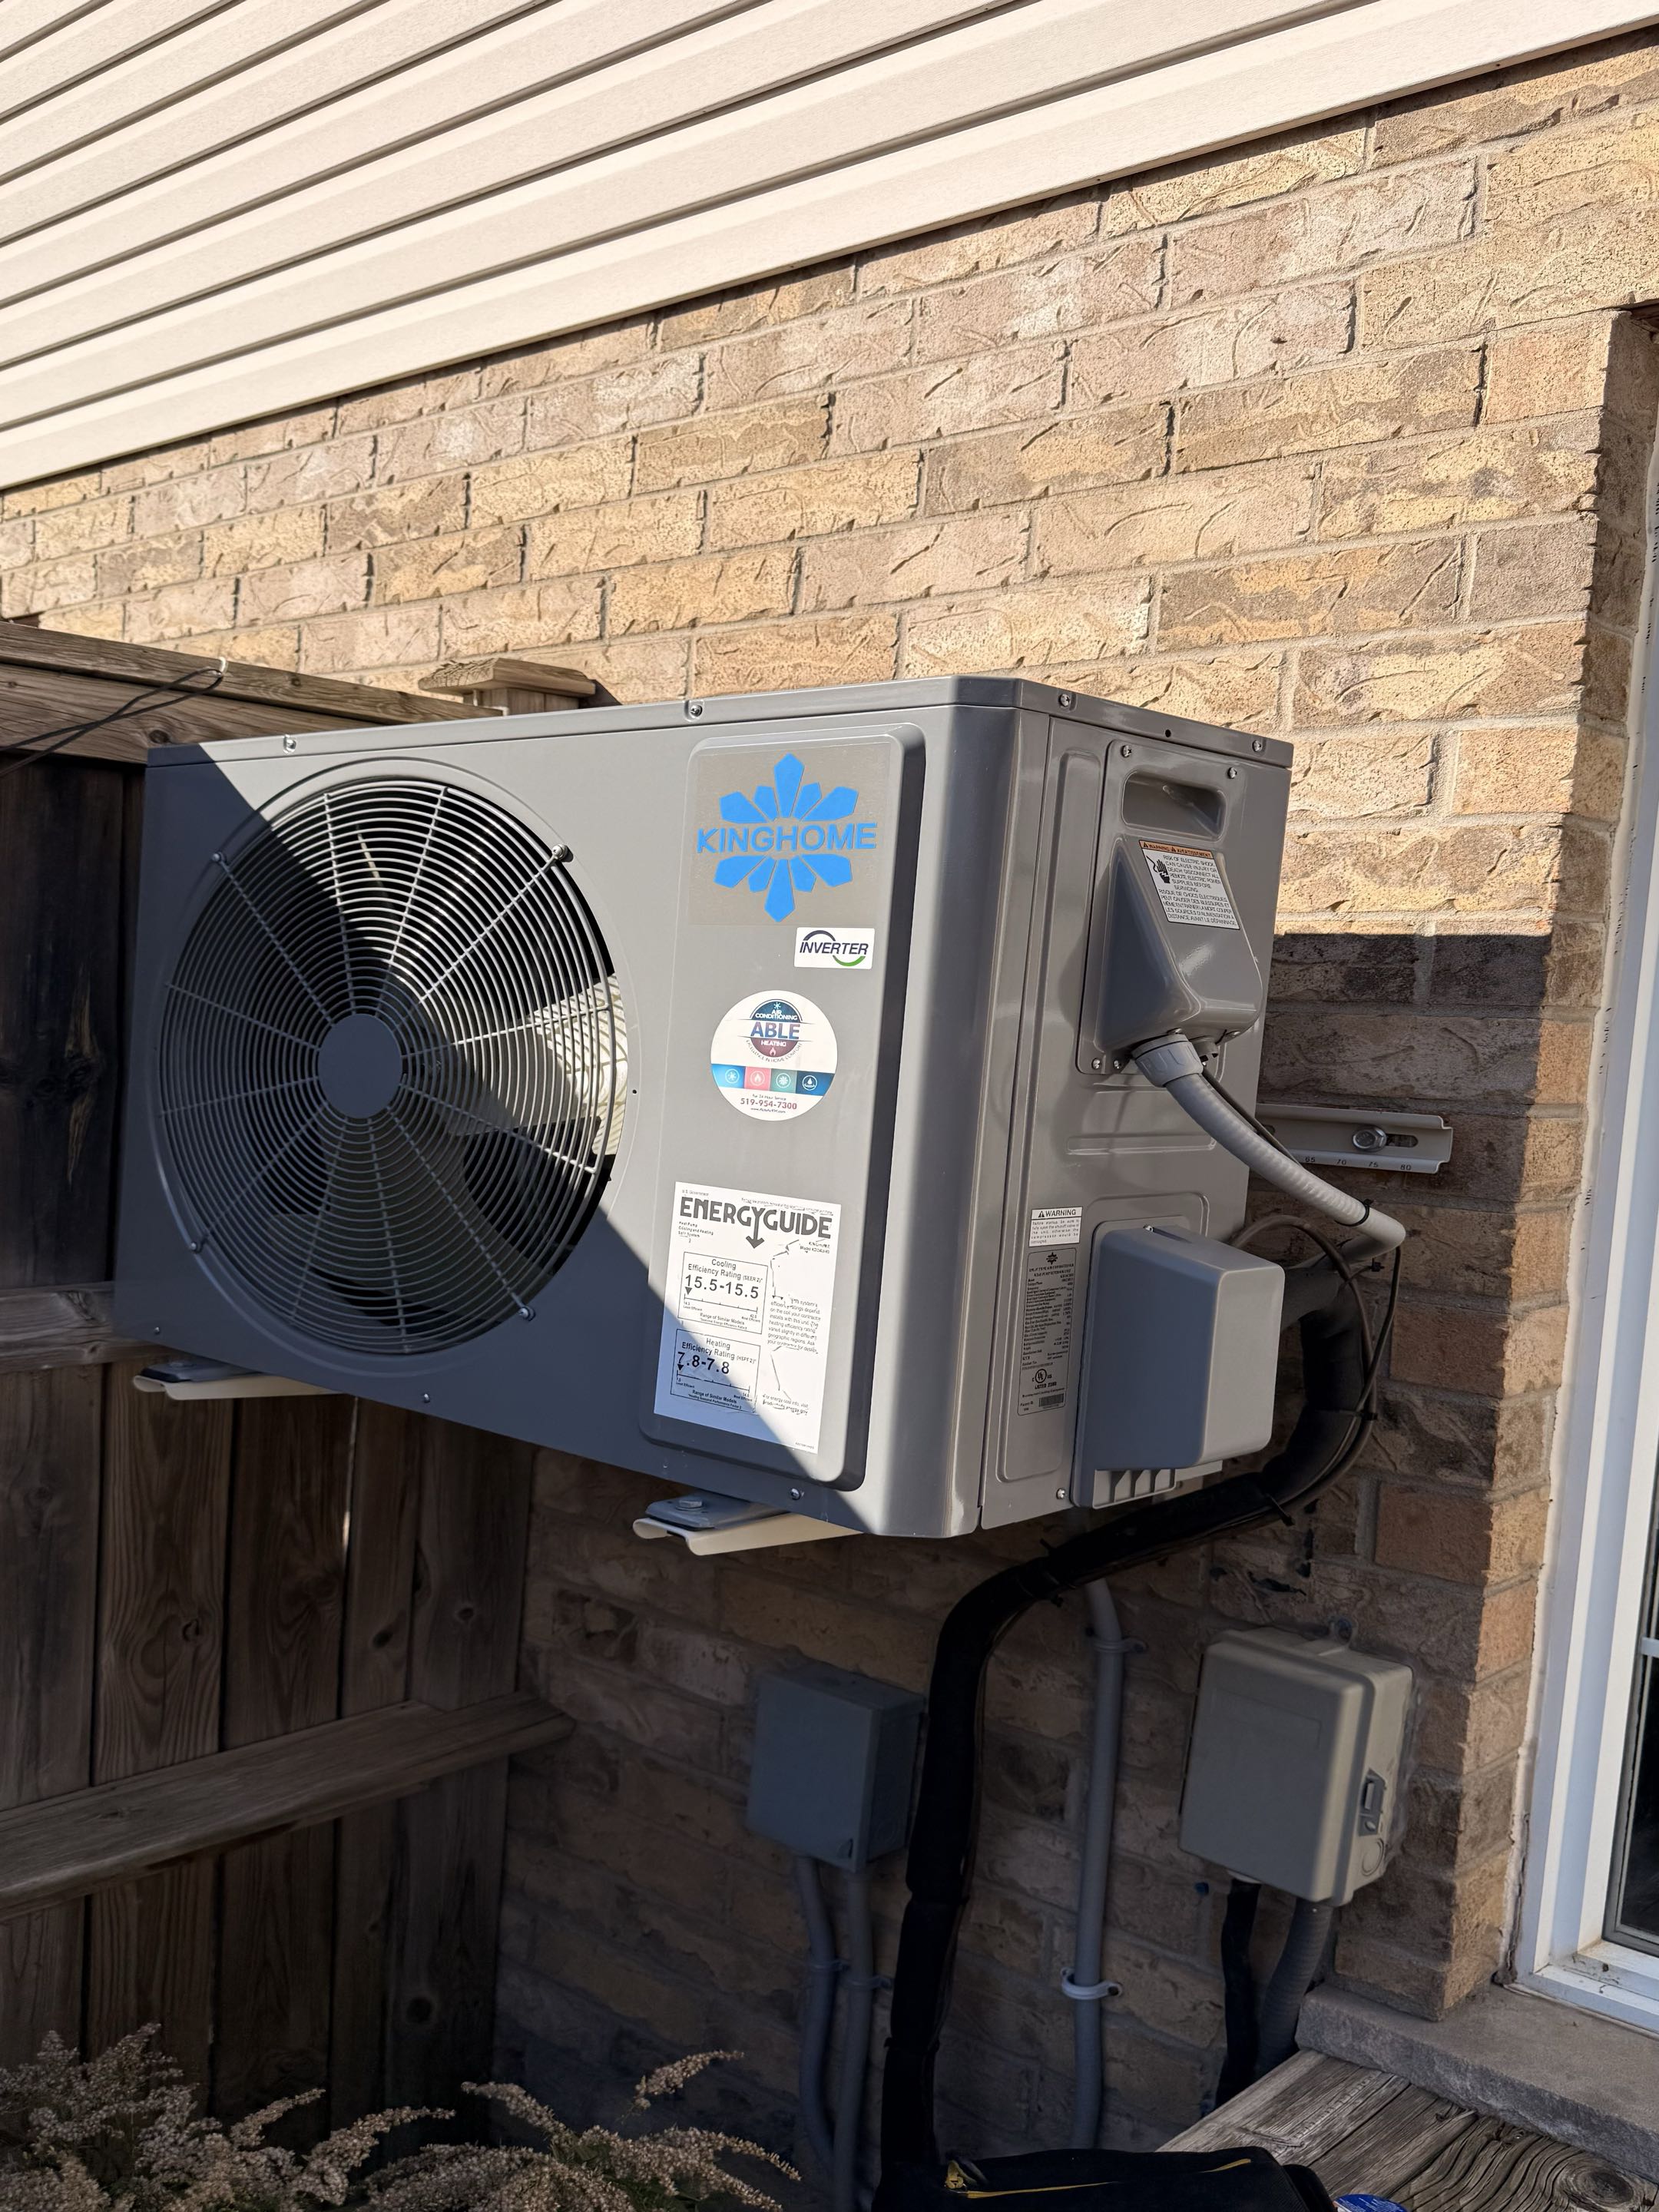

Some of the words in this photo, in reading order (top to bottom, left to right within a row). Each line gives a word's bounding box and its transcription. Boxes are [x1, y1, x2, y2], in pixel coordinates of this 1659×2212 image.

[697, 823, 877, 853] KINGHOME
[800, 942, 869, 955] INVERTER
[755, 1013, 798, 1022] CONDITIONING
[750, 1022, 800, 1040] ABLE
[740, 1098, 797, 1110] 519-954-7300
[680, 1196, 832, 1239] ENERGYGUIDE
[688, 1263, 719, 1277] Efficiency
[720, 1269, 741, 1280] Rating
[711, 1259, 737, 1270] Cooling
[685, 1274, 759, 1299] 15.5-15.5
[682, 1342, 713, 1356] Efficiency
[714, 1348, 735, 1361] Rating
[706, 1337, 730, 1351] Heating
[677, 1351, 730, 1374] 7.8-7.8
